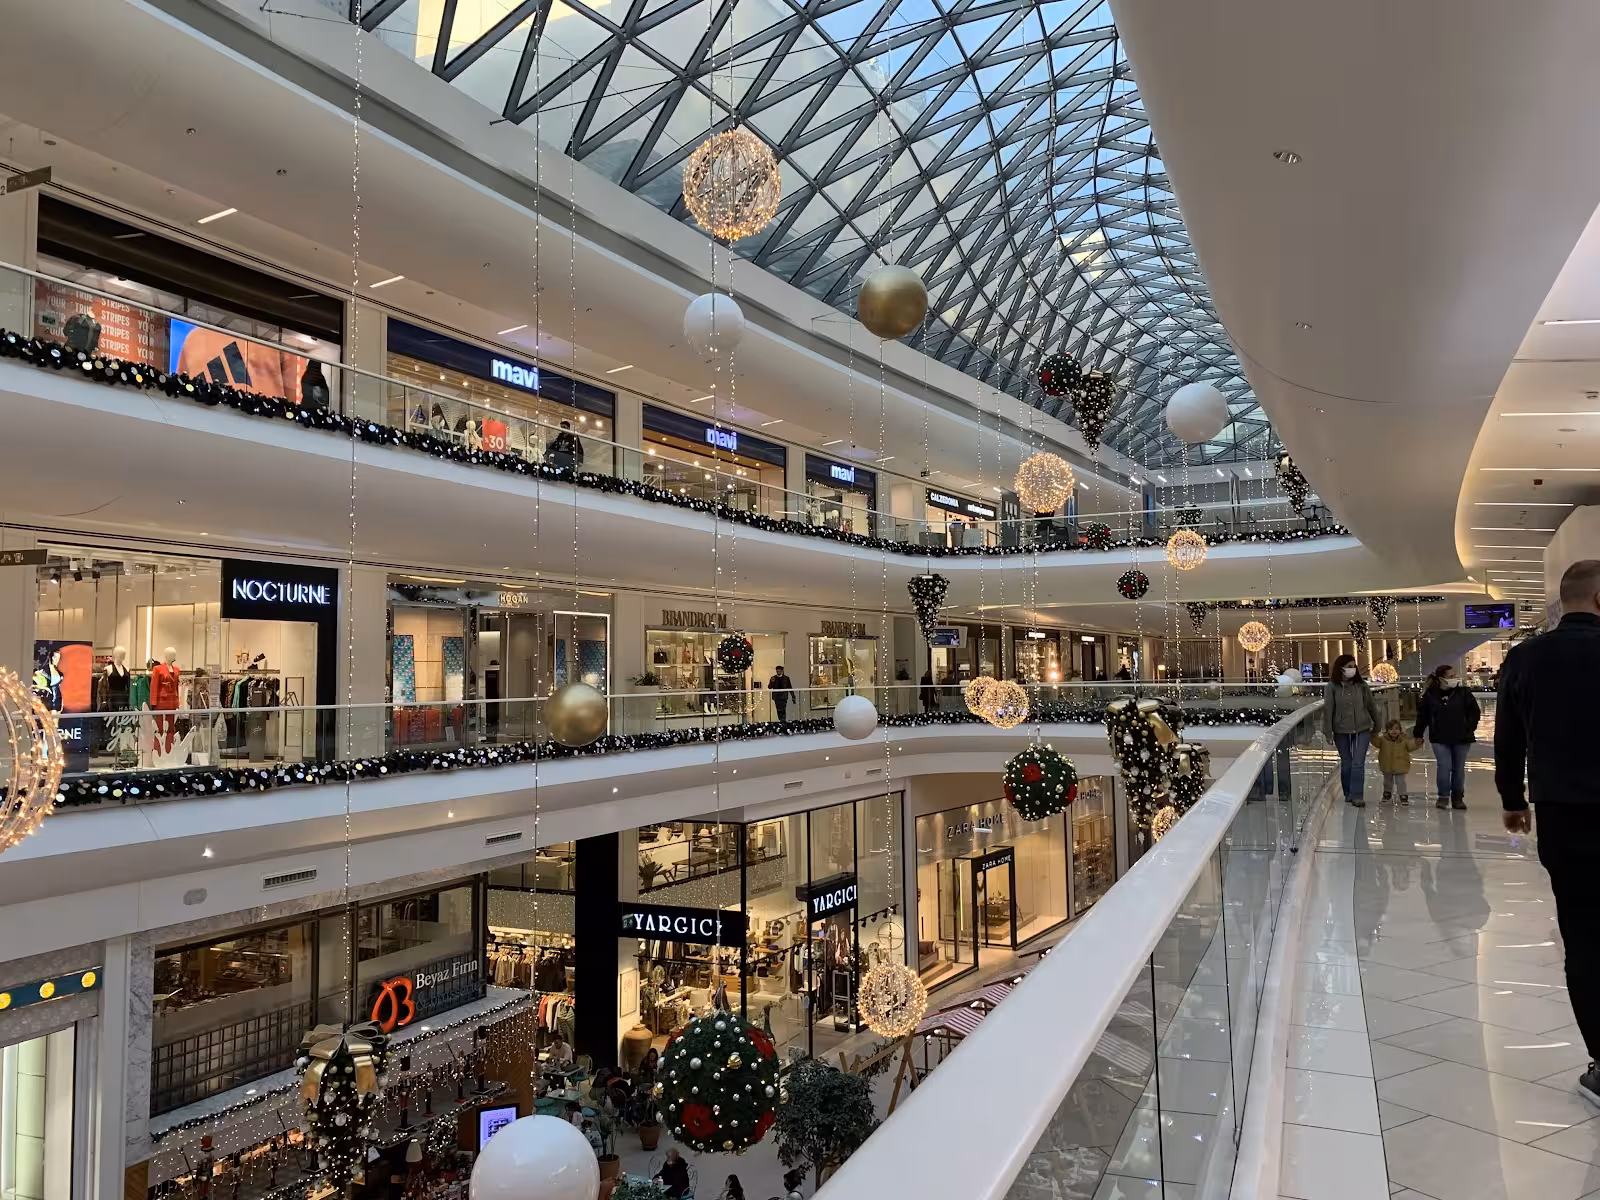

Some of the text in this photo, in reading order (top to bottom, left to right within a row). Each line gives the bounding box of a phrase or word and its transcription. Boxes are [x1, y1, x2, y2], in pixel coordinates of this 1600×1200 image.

[101, 298, 130, 312] STRIPES
[101, 310, 130, 326] STRIPES
[100, 324, 130, 341] STRIPES
[100, 337, 130, 355] STRIPES
[491, 358, 539, 391] mavi
[706, 428, 737, 451] mavi
[830, 464, 855, 483] mavi
[232, 578, 331, 605] NOCTURNE
[661, 609, 728, 629] BRANDROOM
[947, 812, 1006, 838] ZARA HOME
[982, 860, 997, 870] ZARA
[415, 967, 450, 989] Beyaz
